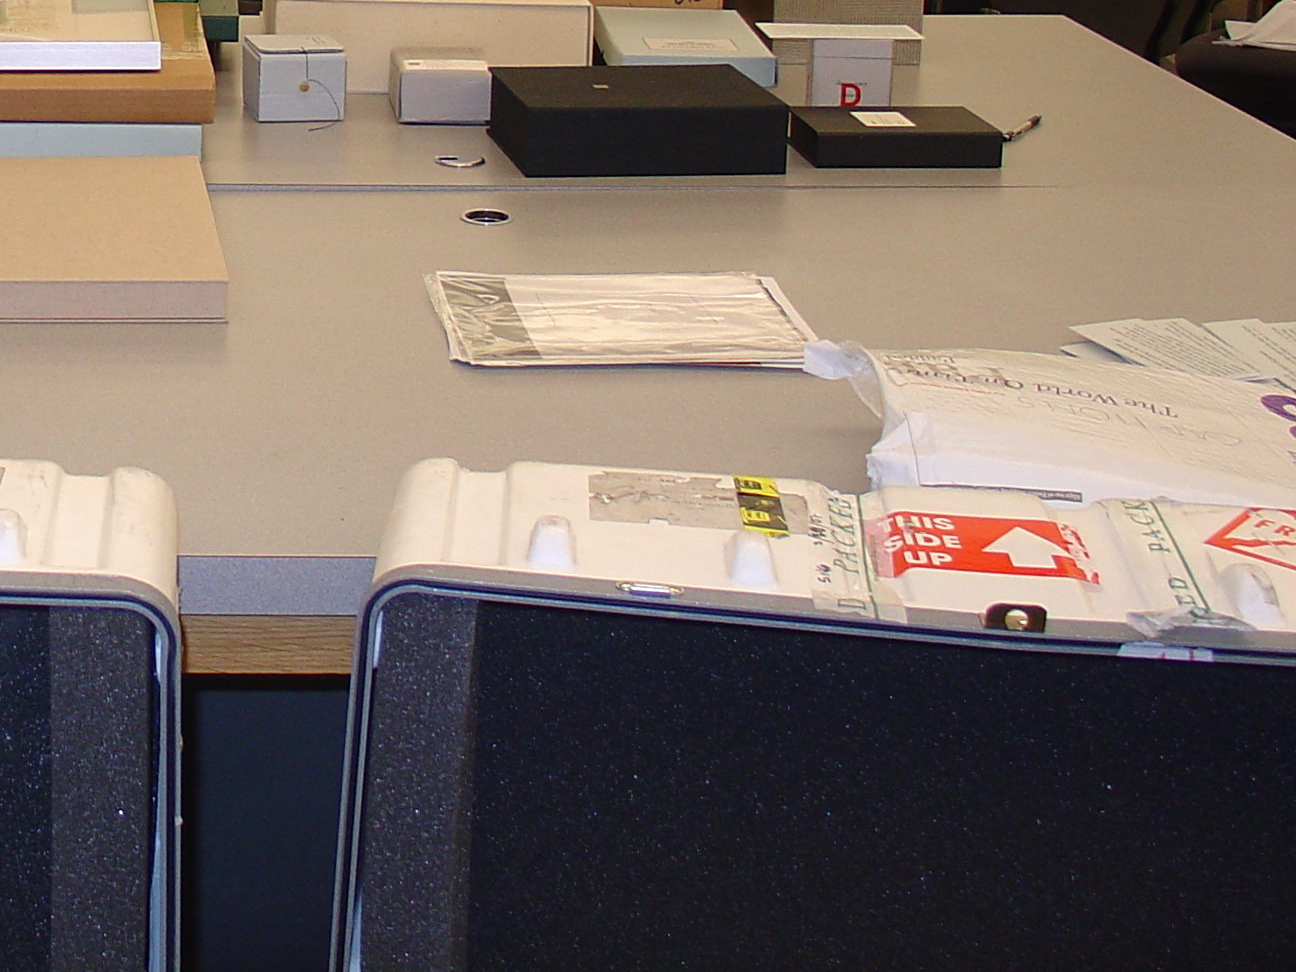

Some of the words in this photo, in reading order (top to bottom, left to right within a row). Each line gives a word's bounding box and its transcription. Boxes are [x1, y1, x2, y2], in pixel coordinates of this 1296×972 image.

[840, 82, 861, 108] D
[983, 373, 1025, 391] On
[1031, 382, 1120, 409] World
[1124, 397, 1179, 419] The
[876, 514, 956, 533] THIS
[883, 531, 962, 554] SIDE
[904, 549, 953, 568] UP
